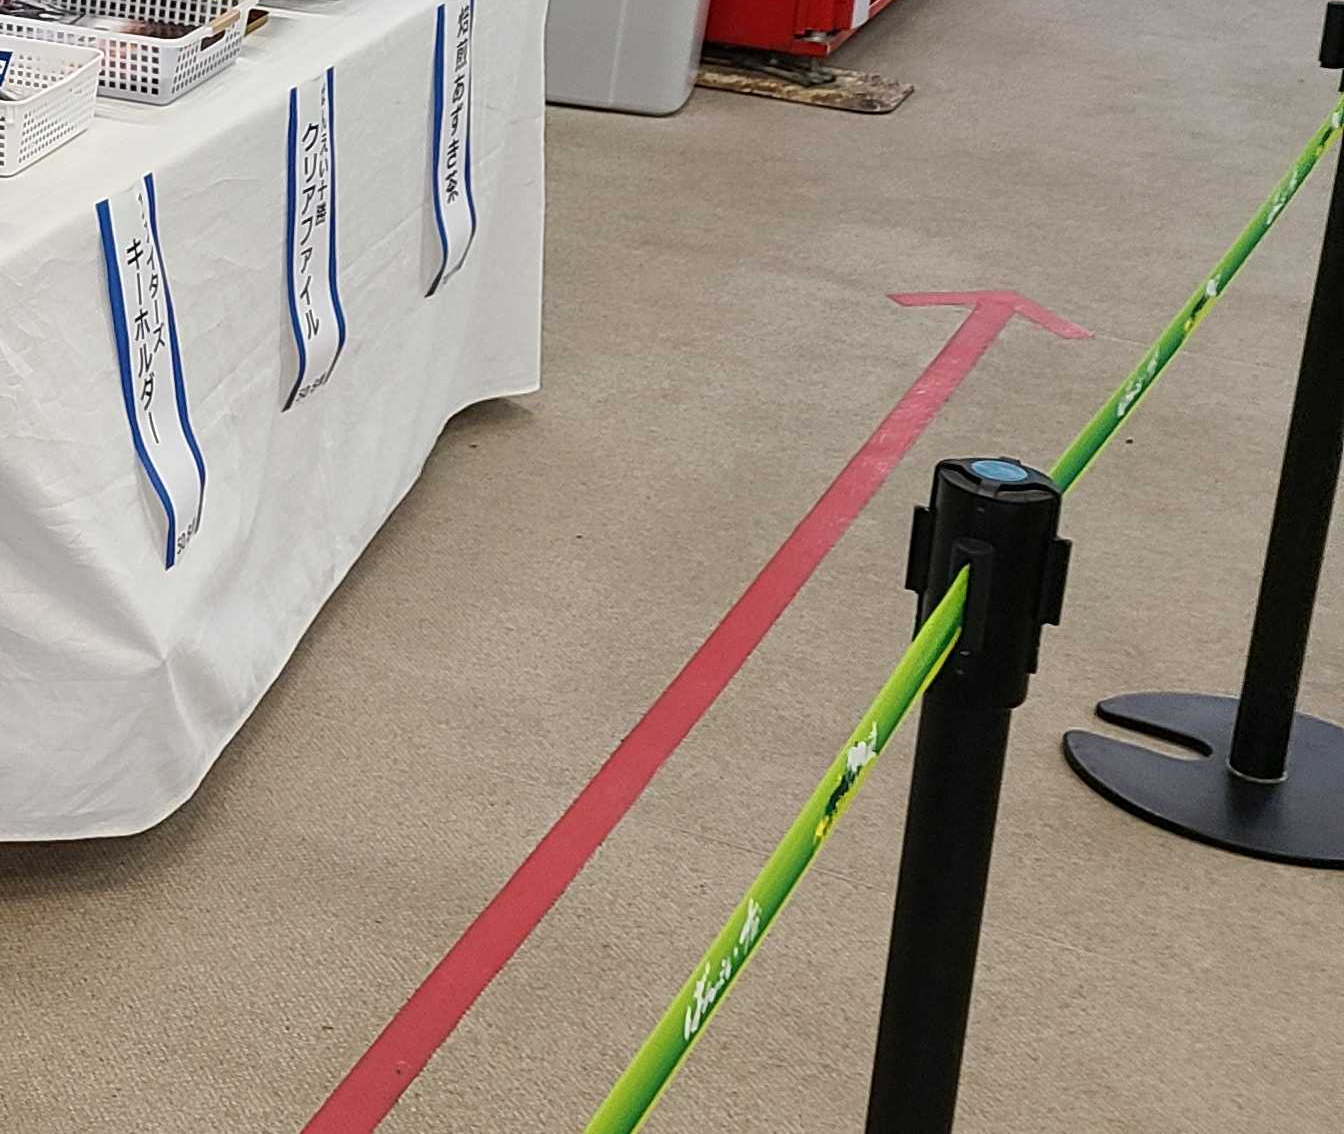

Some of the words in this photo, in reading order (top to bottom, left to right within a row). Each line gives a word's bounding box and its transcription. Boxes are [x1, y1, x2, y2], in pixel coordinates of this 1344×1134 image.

[137, 193, 166, 356] イターズ
[300, 122, 320, 340] クリアファイル
[126, 238, 160, 444] キーホルダー
